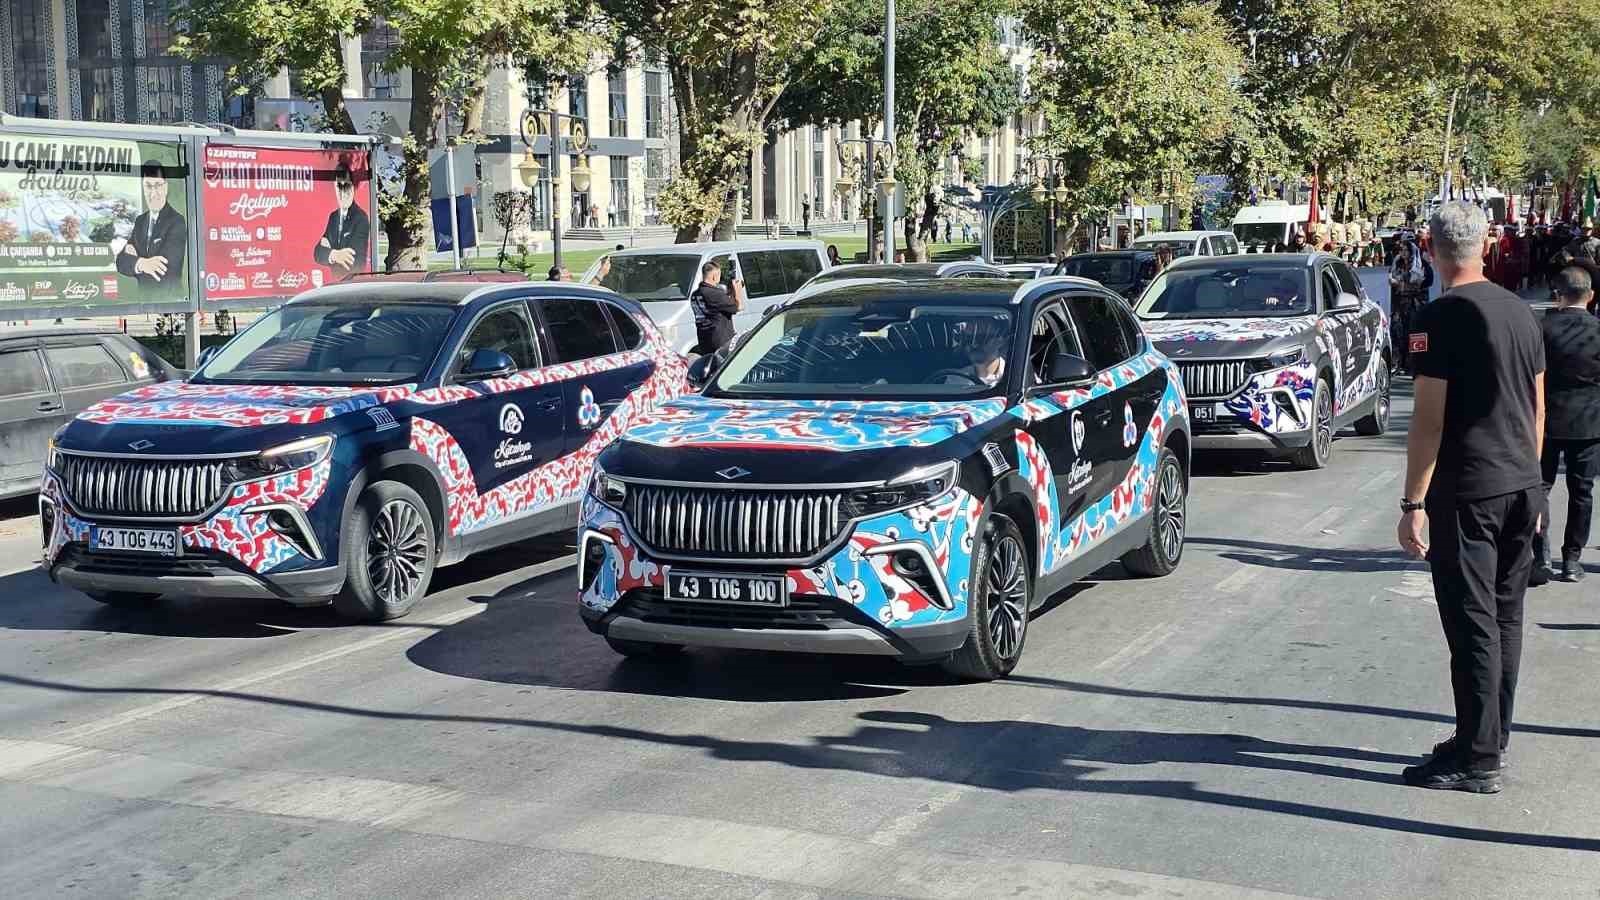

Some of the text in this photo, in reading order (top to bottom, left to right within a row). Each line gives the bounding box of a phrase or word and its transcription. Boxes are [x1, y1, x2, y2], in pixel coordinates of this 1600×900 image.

[62, 144, 133, 173] MEYDANI
[1194, 407, 1213, 419] 051
[99, 529, 175, 550] 43 TOG 443
[679, 576, 776, 602] 43 TOG 100
